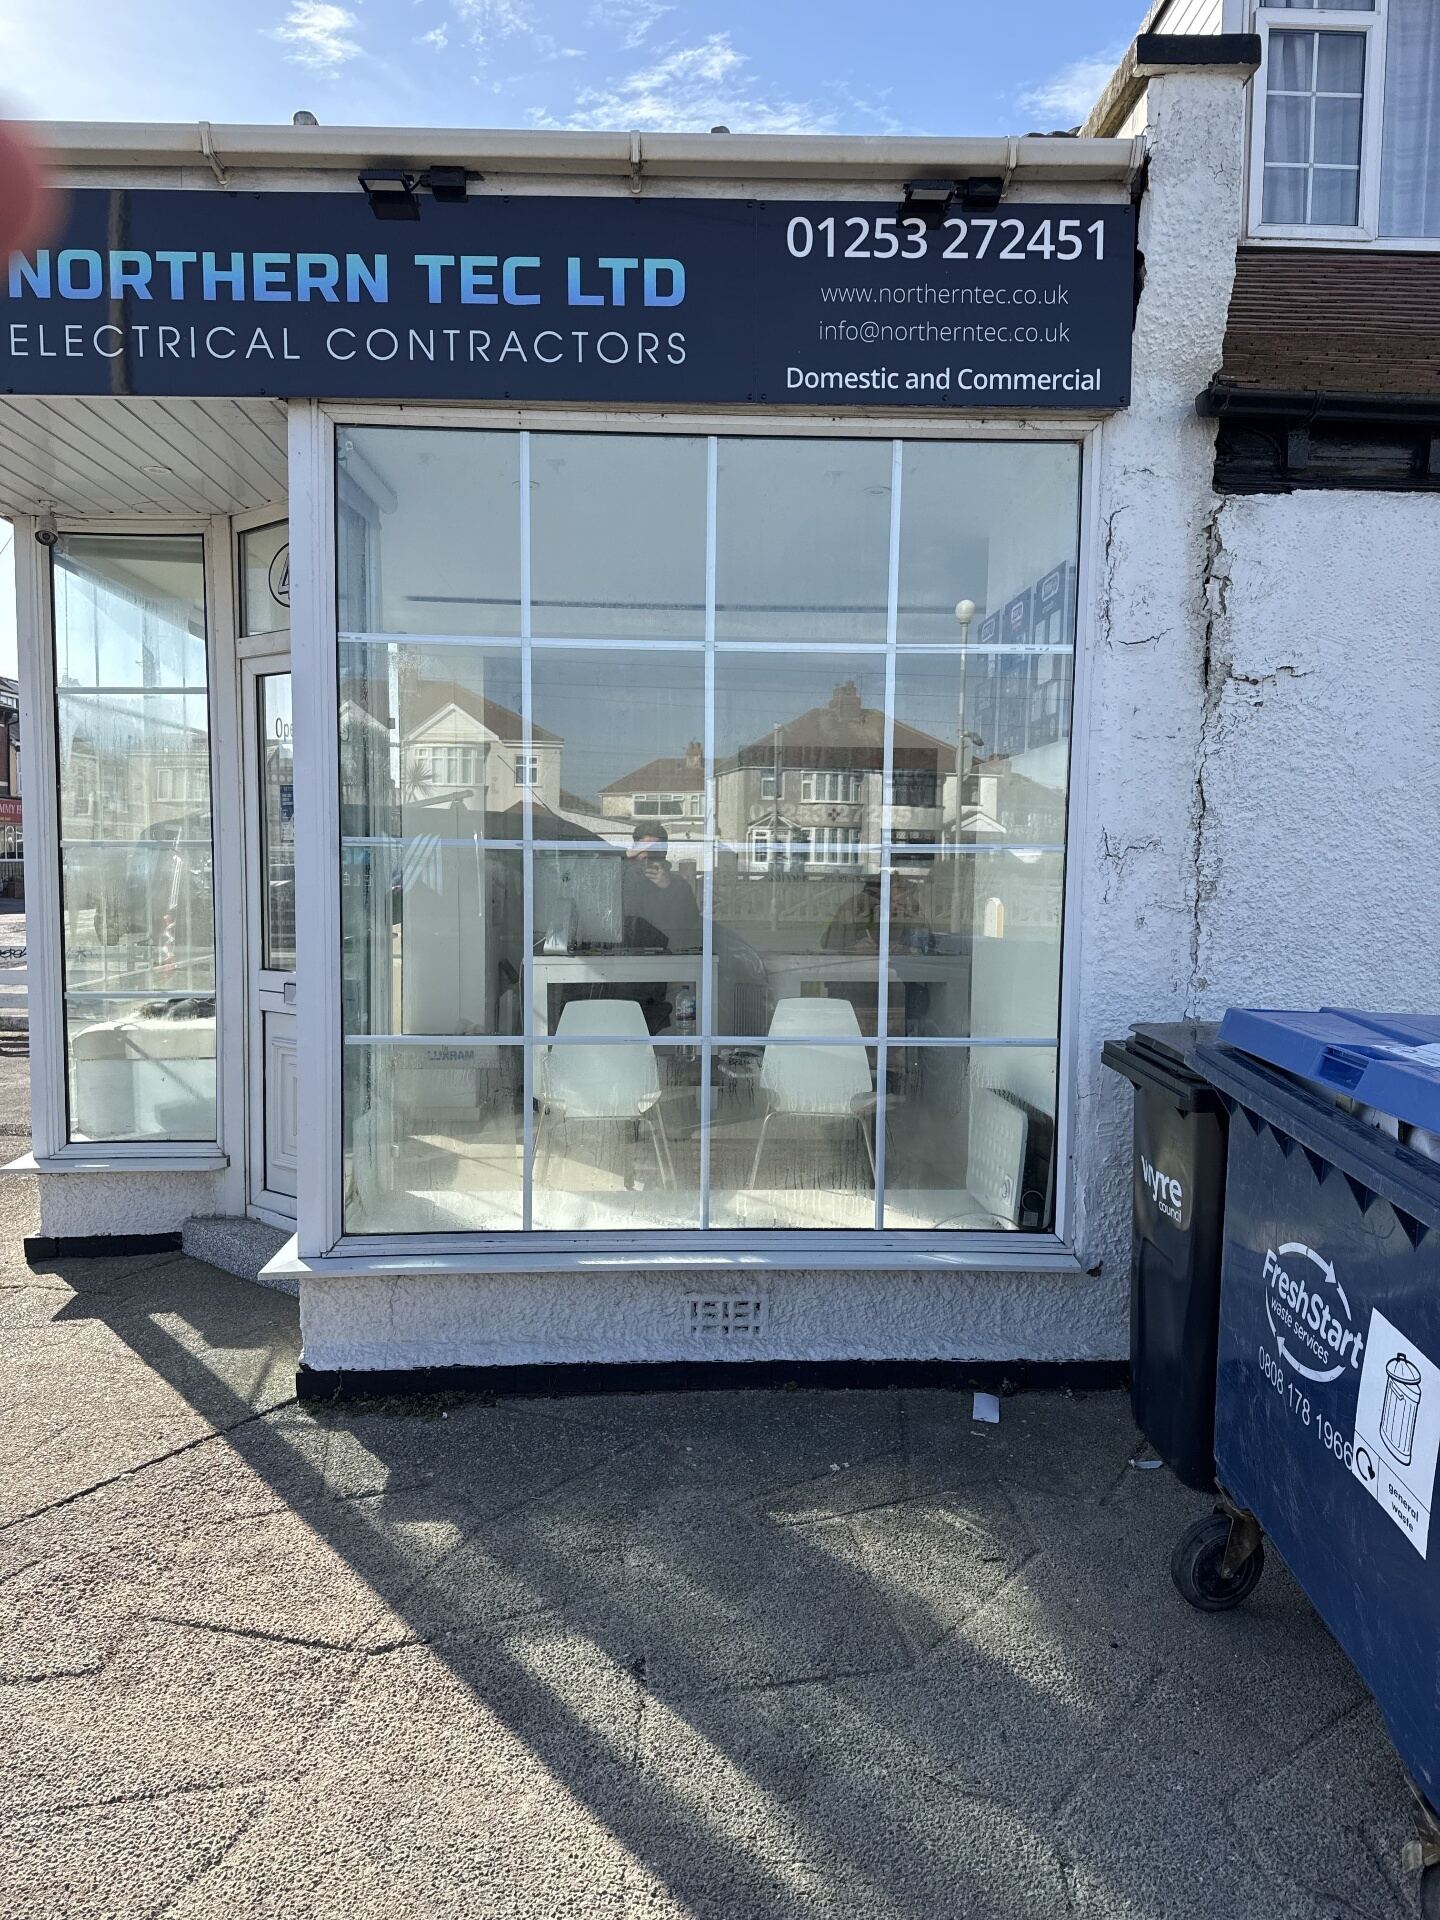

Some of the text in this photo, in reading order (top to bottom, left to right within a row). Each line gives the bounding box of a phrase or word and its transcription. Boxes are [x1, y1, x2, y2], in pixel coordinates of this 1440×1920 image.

[786, 216, 1105, 261] 01253 272451
[8, 249, 686, 307] NORTHERN TEC LTD
[820, 283, 1069, 305] www.northerntec.co.uk
[9, 323, 686, 365] ELECTRICAL CONTRACTORS
[819, 319, 1070, 343] info@northerntec.co.uk
[786, 367, 1101, 391] Domestic and Commercial
[1141, 1155, 1182, 1208] wyre
[1158, 1201, 1182, 1223] council
[1262, 1248, 1364, 1369] FreshStart
[1271, 1296, 1329, 1364] waste services
[1259, 1346, 1354, 1471] 0808 178 1966
[1389, 1483, 1419, 1523] general
[1391, 1501, 1414, 1533] waste
